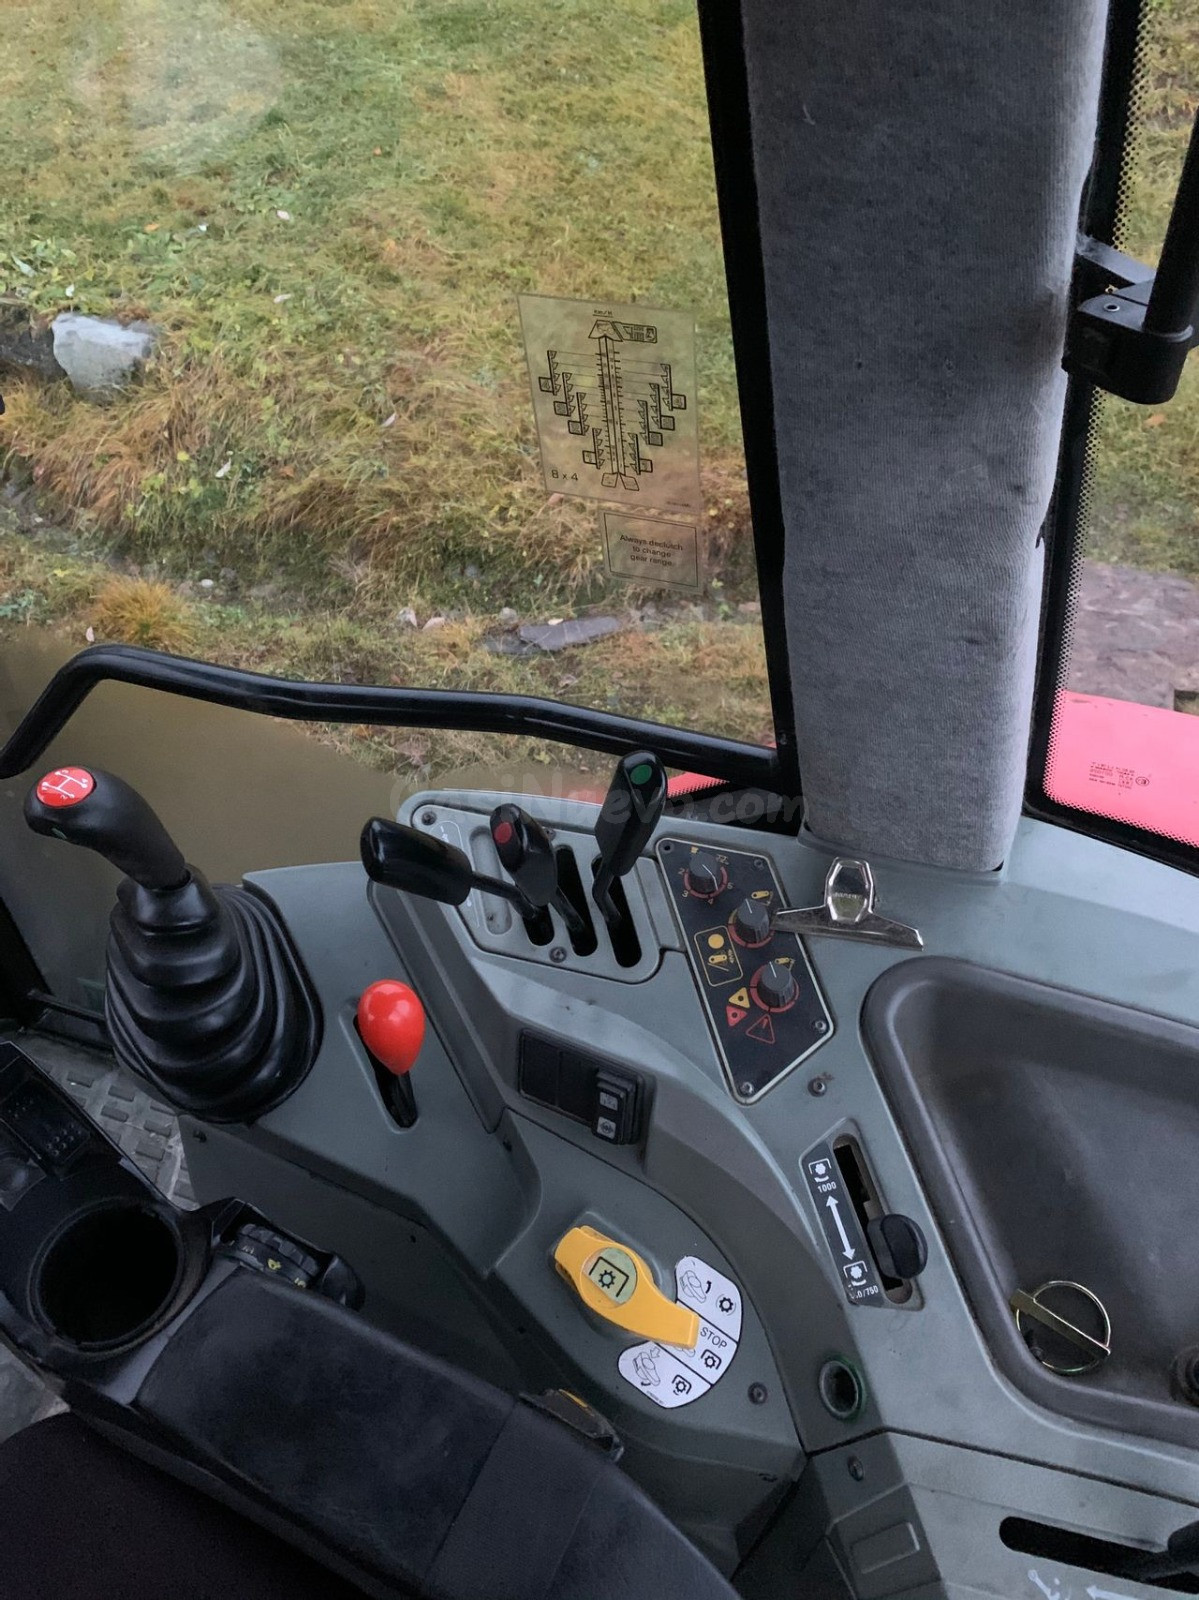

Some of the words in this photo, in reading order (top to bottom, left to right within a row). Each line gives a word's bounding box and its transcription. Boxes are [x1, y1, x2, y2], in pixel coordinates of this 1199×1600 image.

[551, 469, 559, 479] 8
[571, 472, 579, 481] 4
[620, 533, 648, 546] Always
[648, 539, 684, 551] declutch
[632, 545, 641, 553] to
[642, 547, 672, 558] change
[630, 554, 648, 562] gear
[678, 867, 686, 875] 2
[681, 890, 689, 898] 3
[707, 897, 714, 905] 4
[817, 1181, 837, 1194] 1000
[700, 1326, 728, 1349] STOP
